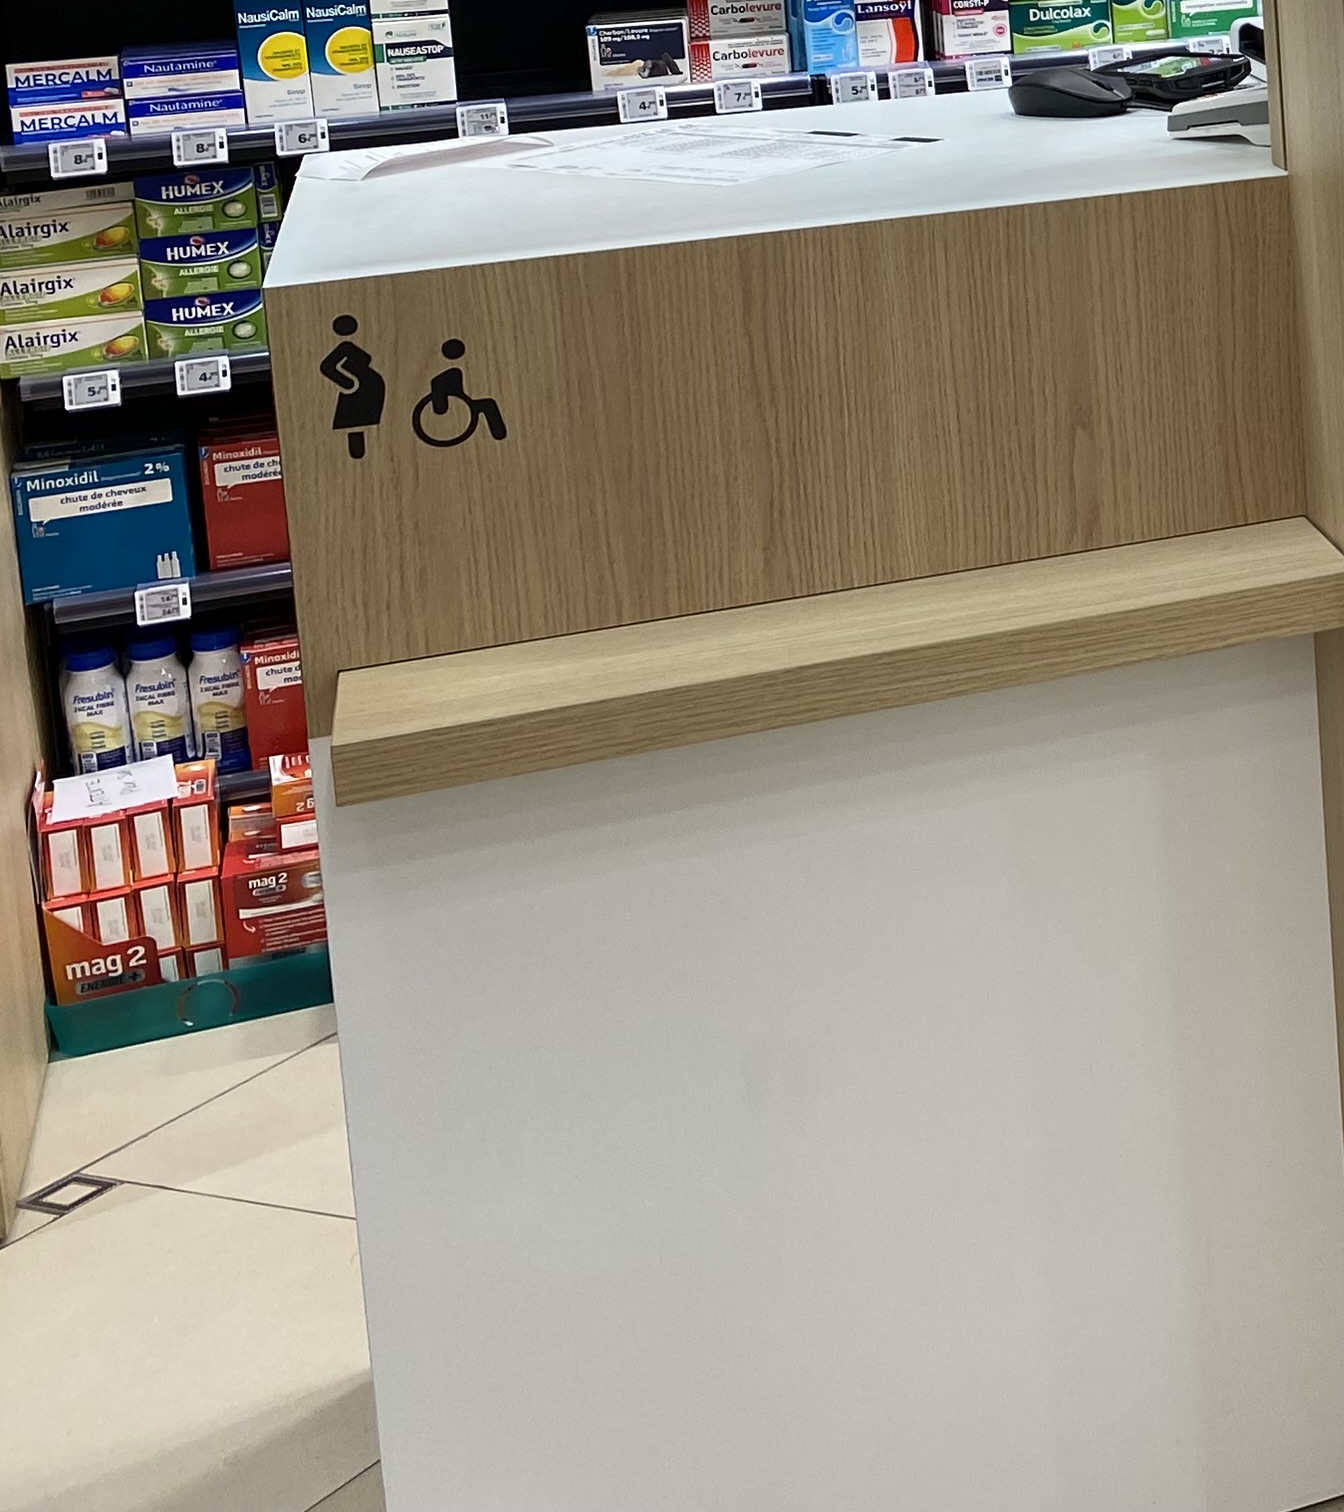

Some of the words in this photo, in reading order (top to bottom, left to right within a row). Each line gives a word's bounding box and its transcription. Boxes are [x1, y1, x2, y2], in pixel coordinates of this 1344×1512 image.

[238, 8, 300, 25] NausiCalm
[709, 0, 784, 15] Carbolevure
[855, 0, 913, 19] Lansoyl
[1029, 4, 1092, 24] Dulcolax
[143, 58, 217, 73] Nautamine
[15, 67, 114, 88] MERCALM
[20, 110, 119, 132] MERCALM
[161, 180, 225, 199] HUMEX
[166, 242, 229, 260] HUMEX
[5, 329, 79, 350] Alairgix
[212, 447, 262, 460] Minoxidil
[26, 470, 99, 492] Minoxidil
[144, 461, 170, 475] 2%
[60, 494, 88, 504] chute
[91, 492, 102, 501] de
[104, 486, 147, 498] cheveux
[73, 690, 114, 705] Fresubin
[66, 950, 122, 981] mag
[129, 945, 147, 965] 2
